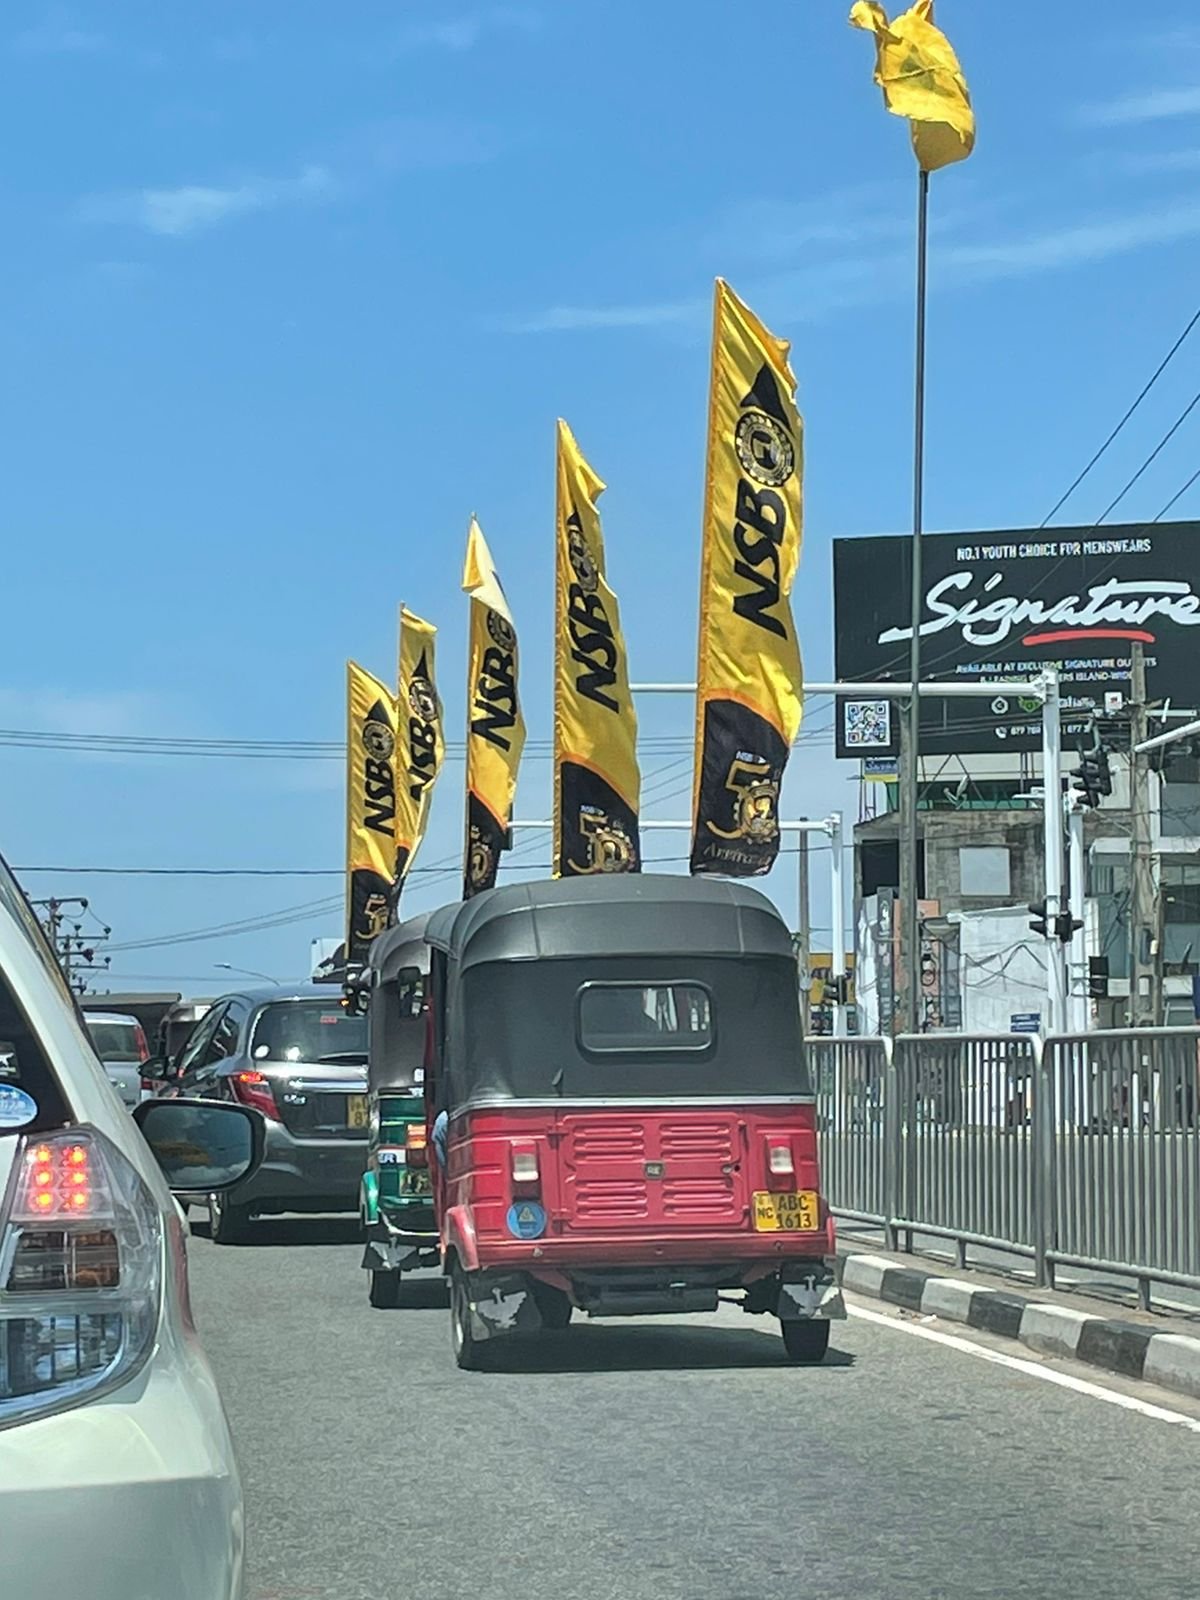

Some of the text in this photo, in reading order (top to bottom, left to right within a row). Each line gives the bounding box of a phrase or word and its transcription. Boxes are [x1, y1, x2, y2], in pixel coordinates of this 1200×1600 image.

[733, 478, 788, 641] NSB
[957, 538, 1151, 561] NO.1 YOUTH CHOICE FOR MENSWEARS
[878, 571, 1200, 646] Signature
[568, 582, 619, 714] NSB
[1004, 662, 1016, 672] AT
[471, 647, 517, 752] NSB
[364, 756, 396, 838] NSB
[776, 1213, 812, 1229] 1613
[778, 1195, 809, 1211] ABC
